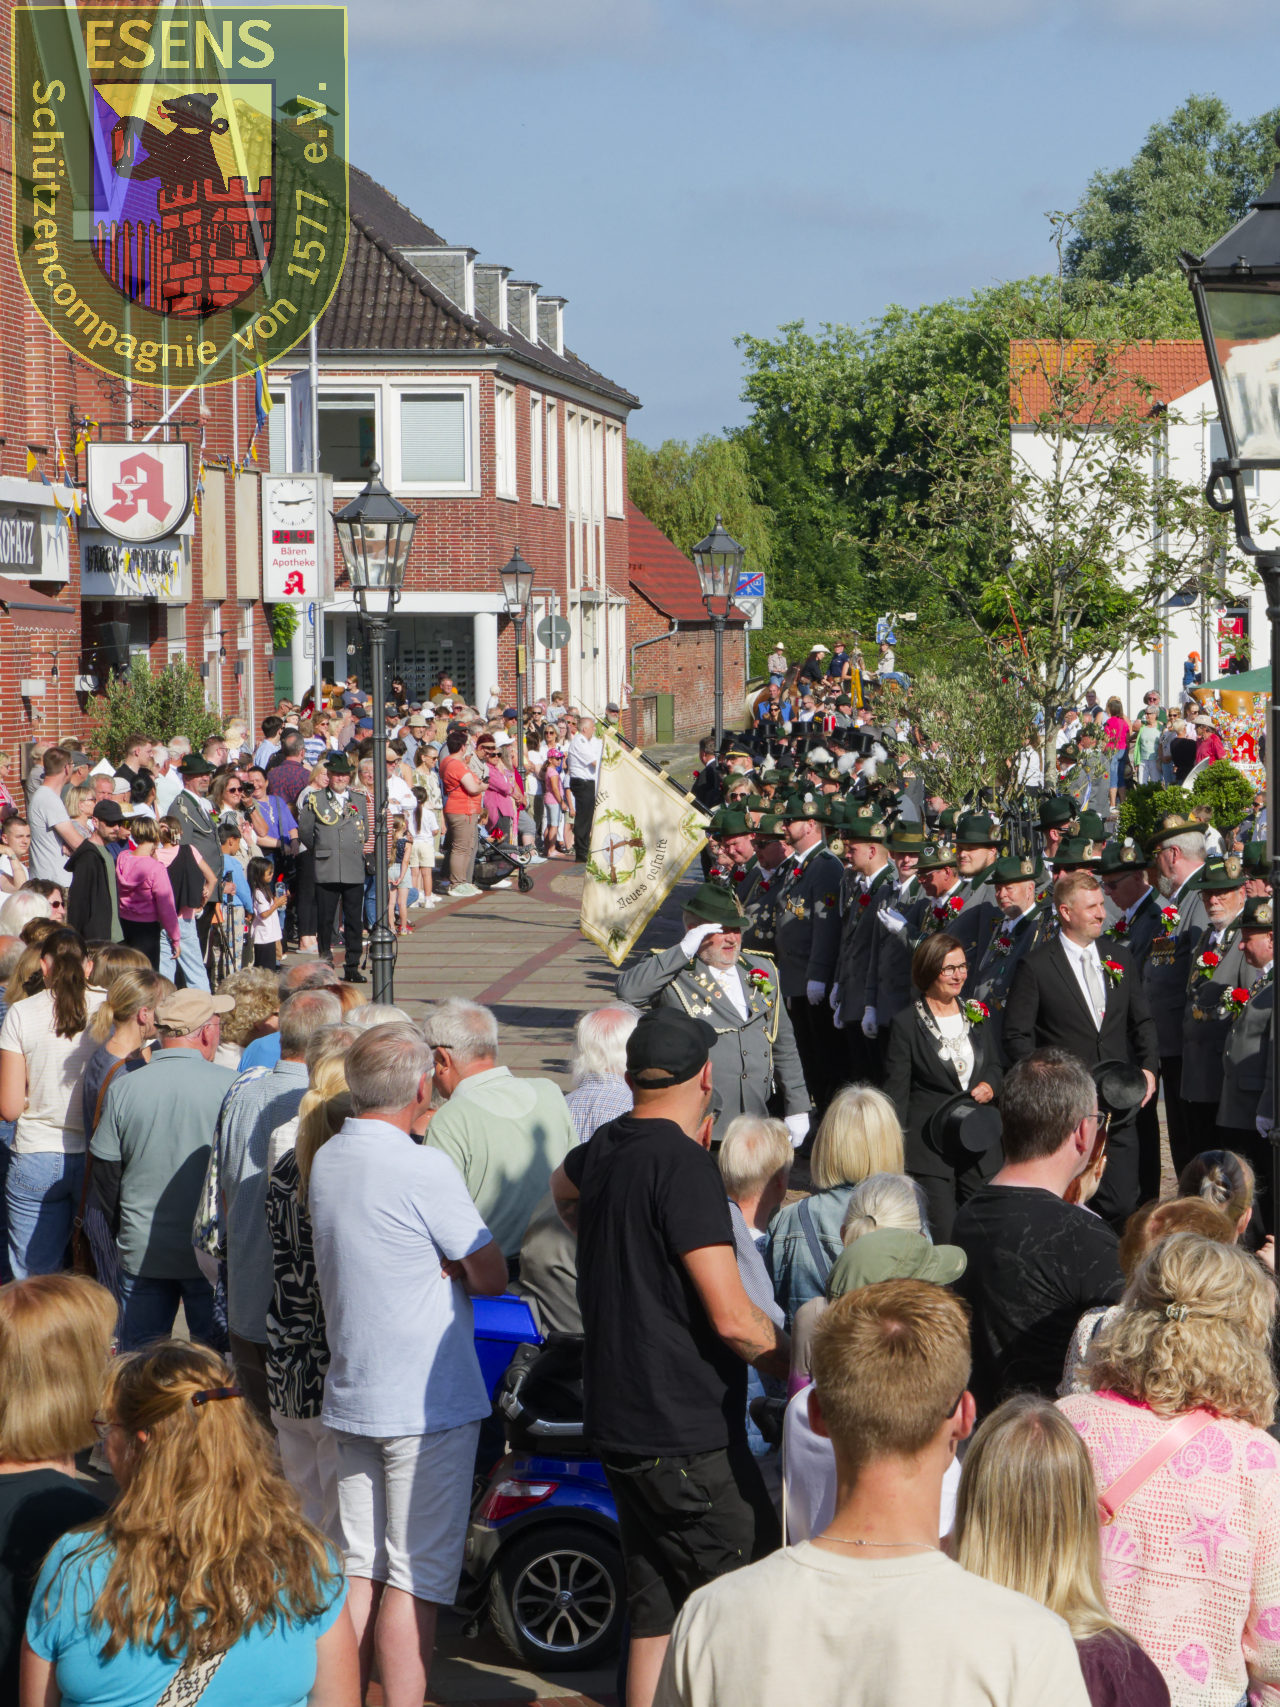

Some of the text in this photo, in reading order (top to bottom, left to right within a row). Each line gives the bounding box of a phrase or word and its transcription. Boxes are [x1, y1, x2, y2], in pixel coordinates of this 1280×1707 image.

[272, 530, 290, 544] 23
[280, 547, 307, 555] Bären
[272, 558, 316, 568] Apotheke
